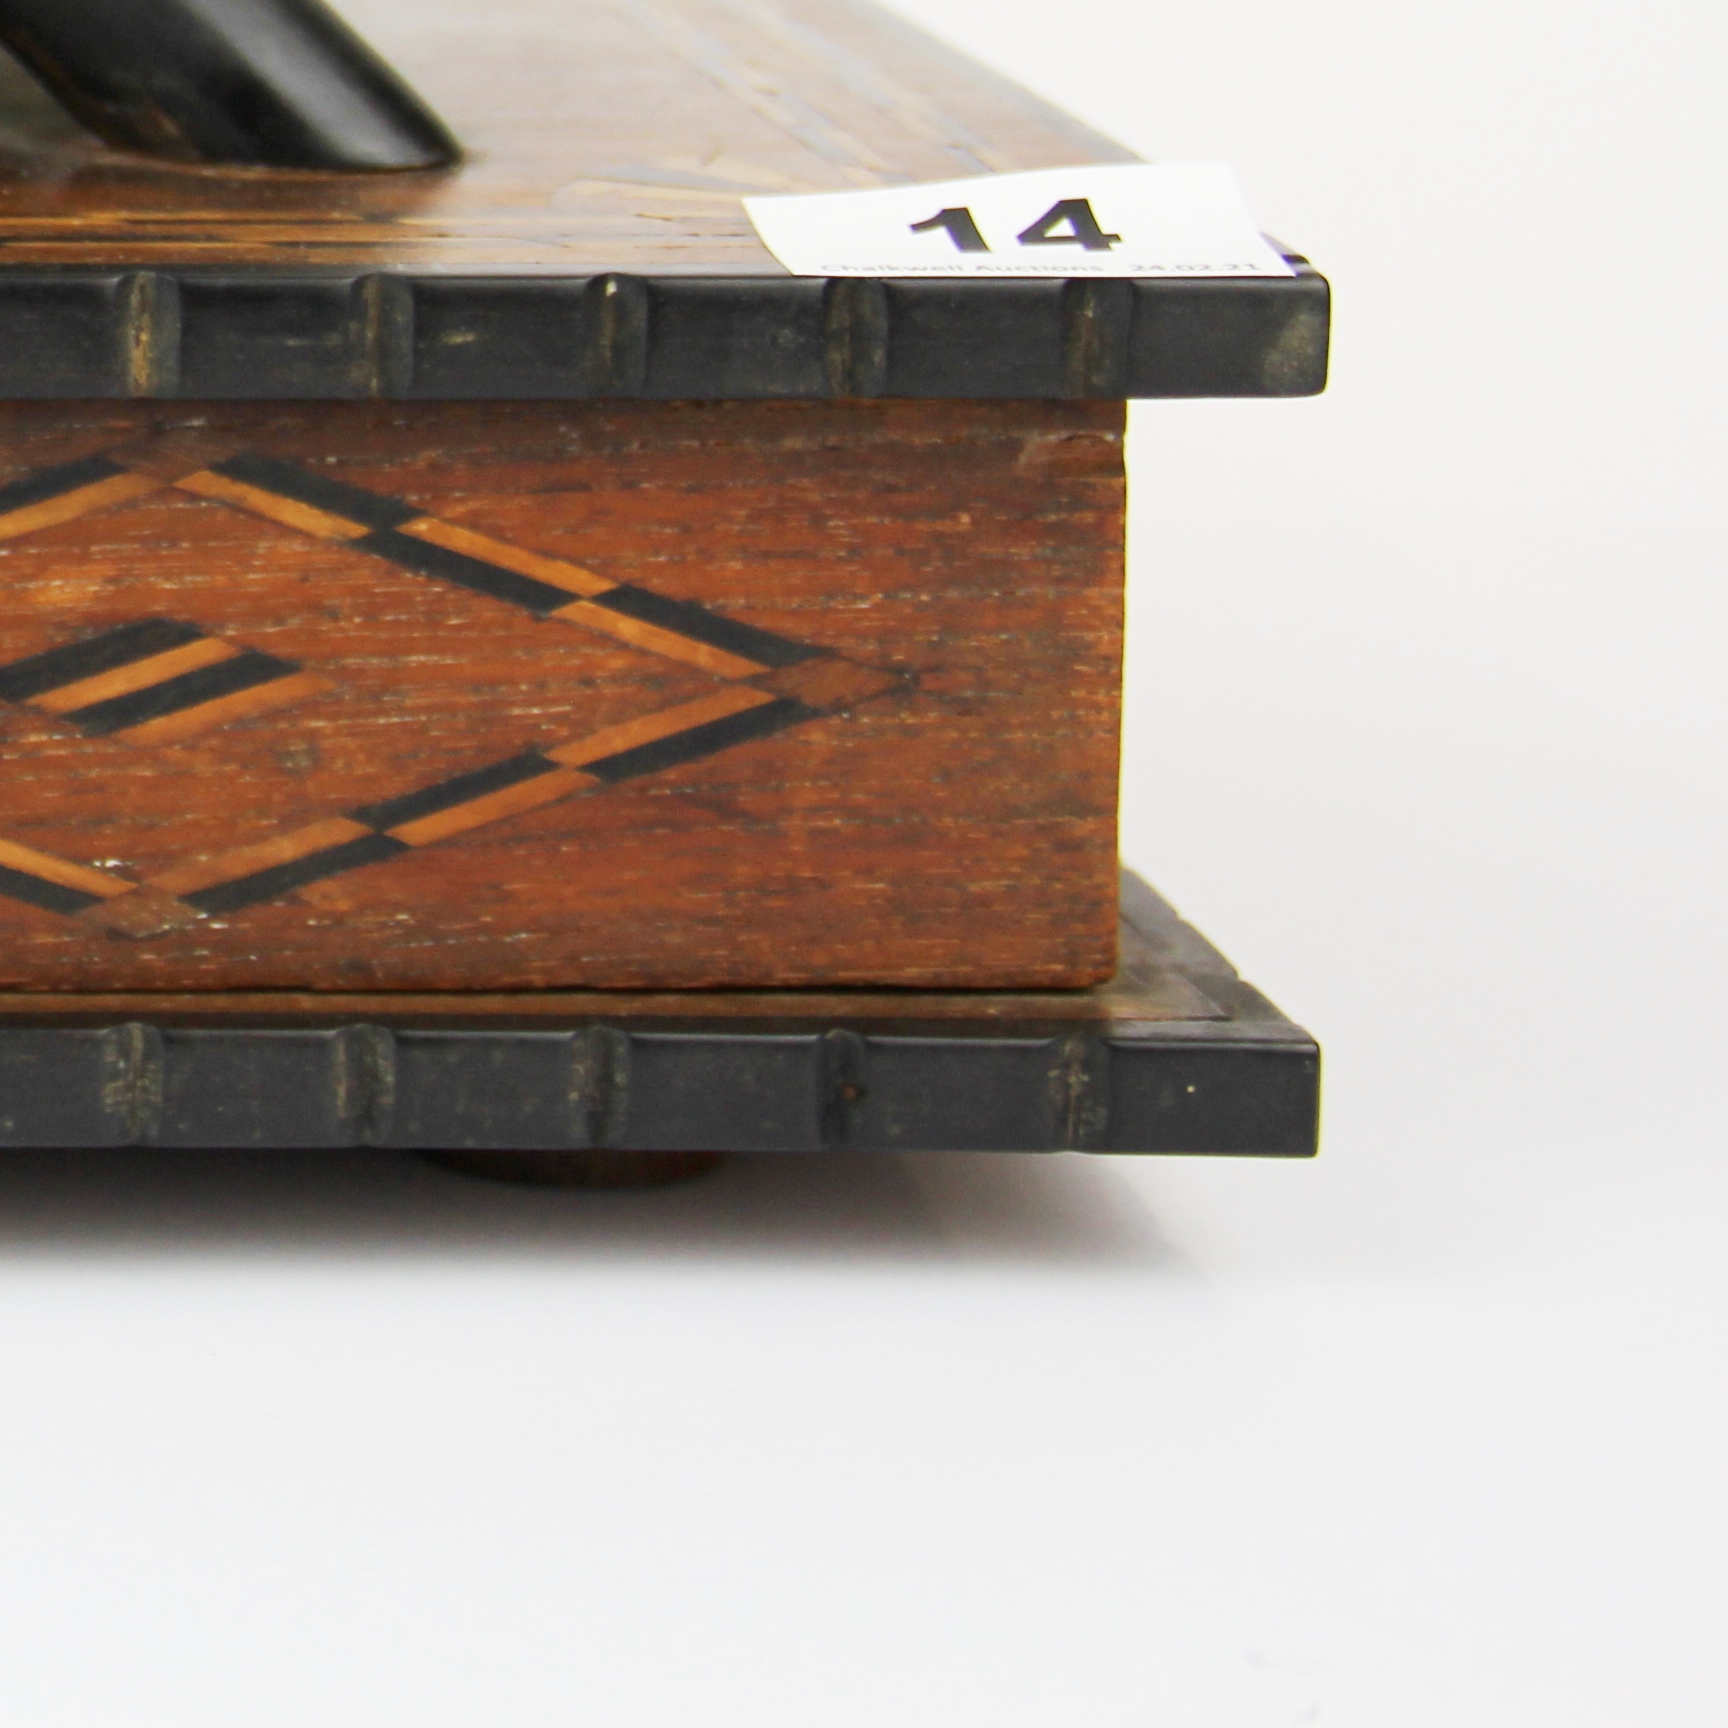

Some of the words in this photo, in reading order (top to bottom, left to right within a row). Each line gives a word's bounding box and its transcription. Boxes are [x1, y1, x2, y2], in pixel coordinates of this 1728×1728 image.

[910, 198, 1122, 251] 14
[820, 263, 965, 272] Chalkwell
[975, 263, 1103, 272] Auctions
